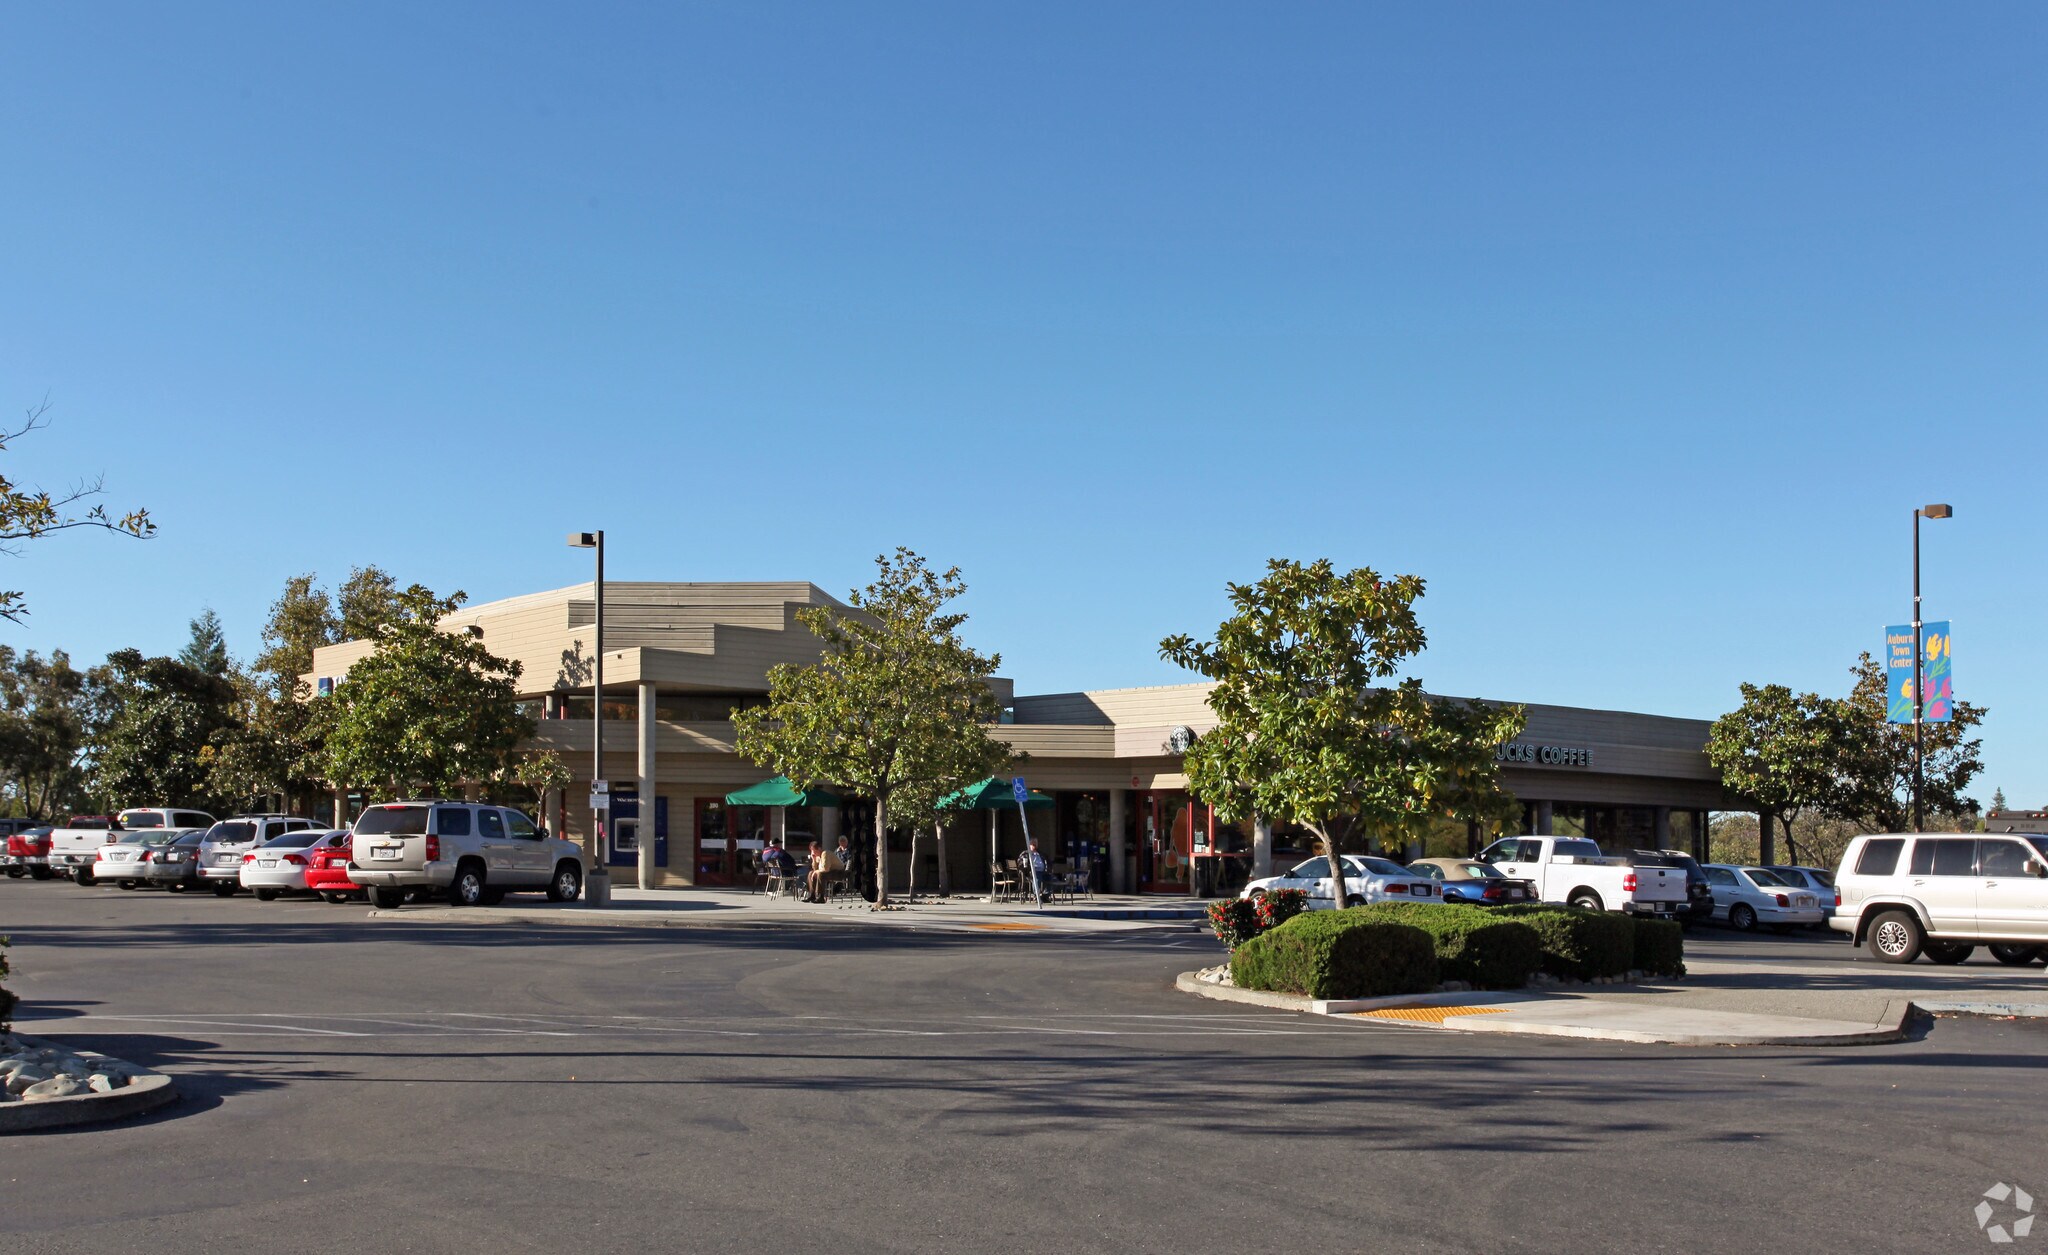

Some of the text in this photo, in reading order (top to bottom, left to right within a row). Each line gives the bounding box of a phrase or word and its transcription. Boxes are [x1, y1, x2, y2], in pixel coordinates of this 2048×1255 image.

[1887, 633, 1914, 645] Auburn
[1892, 646, 1910, 656] Town
[1889, 657, 1912, 668] Center
[1494, 743, 1594, 766] UCKS COFFEE
